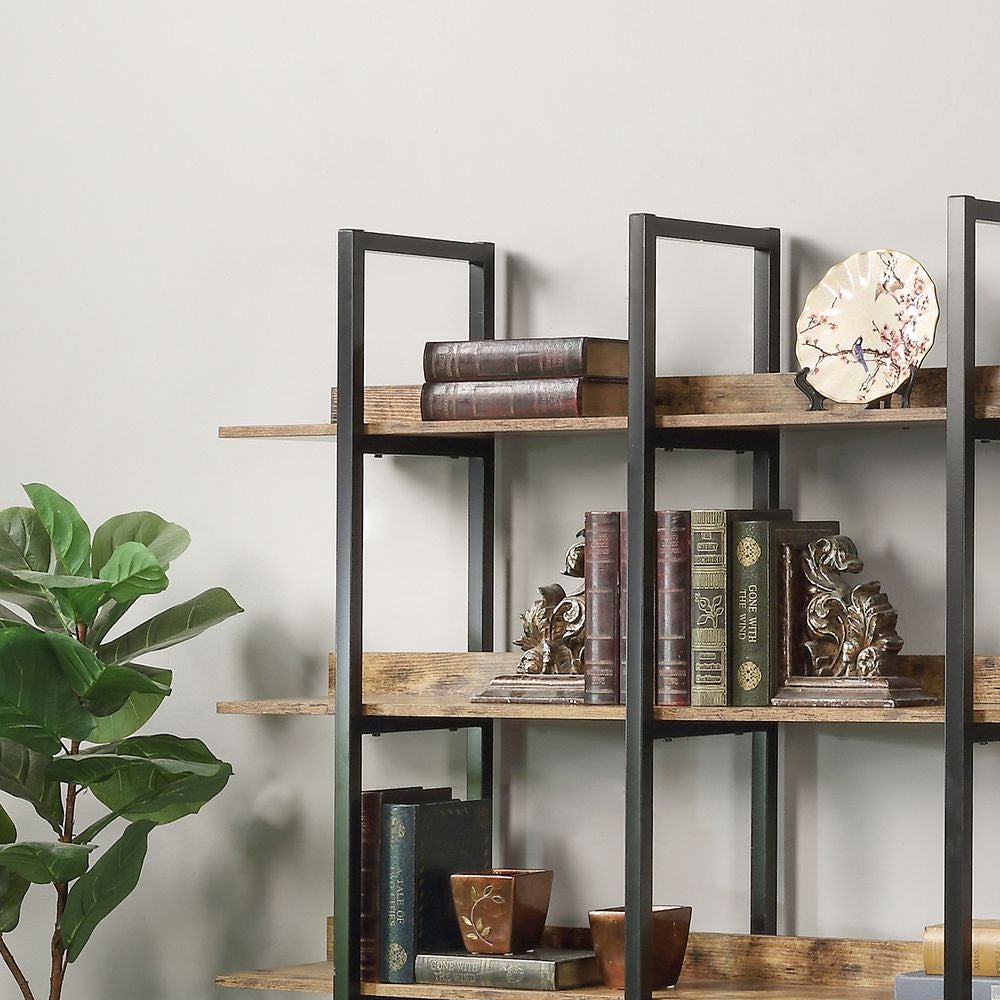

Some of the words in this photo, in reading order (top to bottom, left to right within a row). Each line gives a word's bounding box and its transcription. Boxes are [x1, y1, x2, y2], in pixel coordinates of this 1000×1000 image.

[738, 589, 747, 609] THE
[748, 584, 758, 613] GONE
[738, 613, 747, 640] WIND
[748, 617, 757, 643] WITH
[396, 910, 404, 924] OF
[430, 960, 455, 971] GONE
[455, 962, 480, 972] WITH
